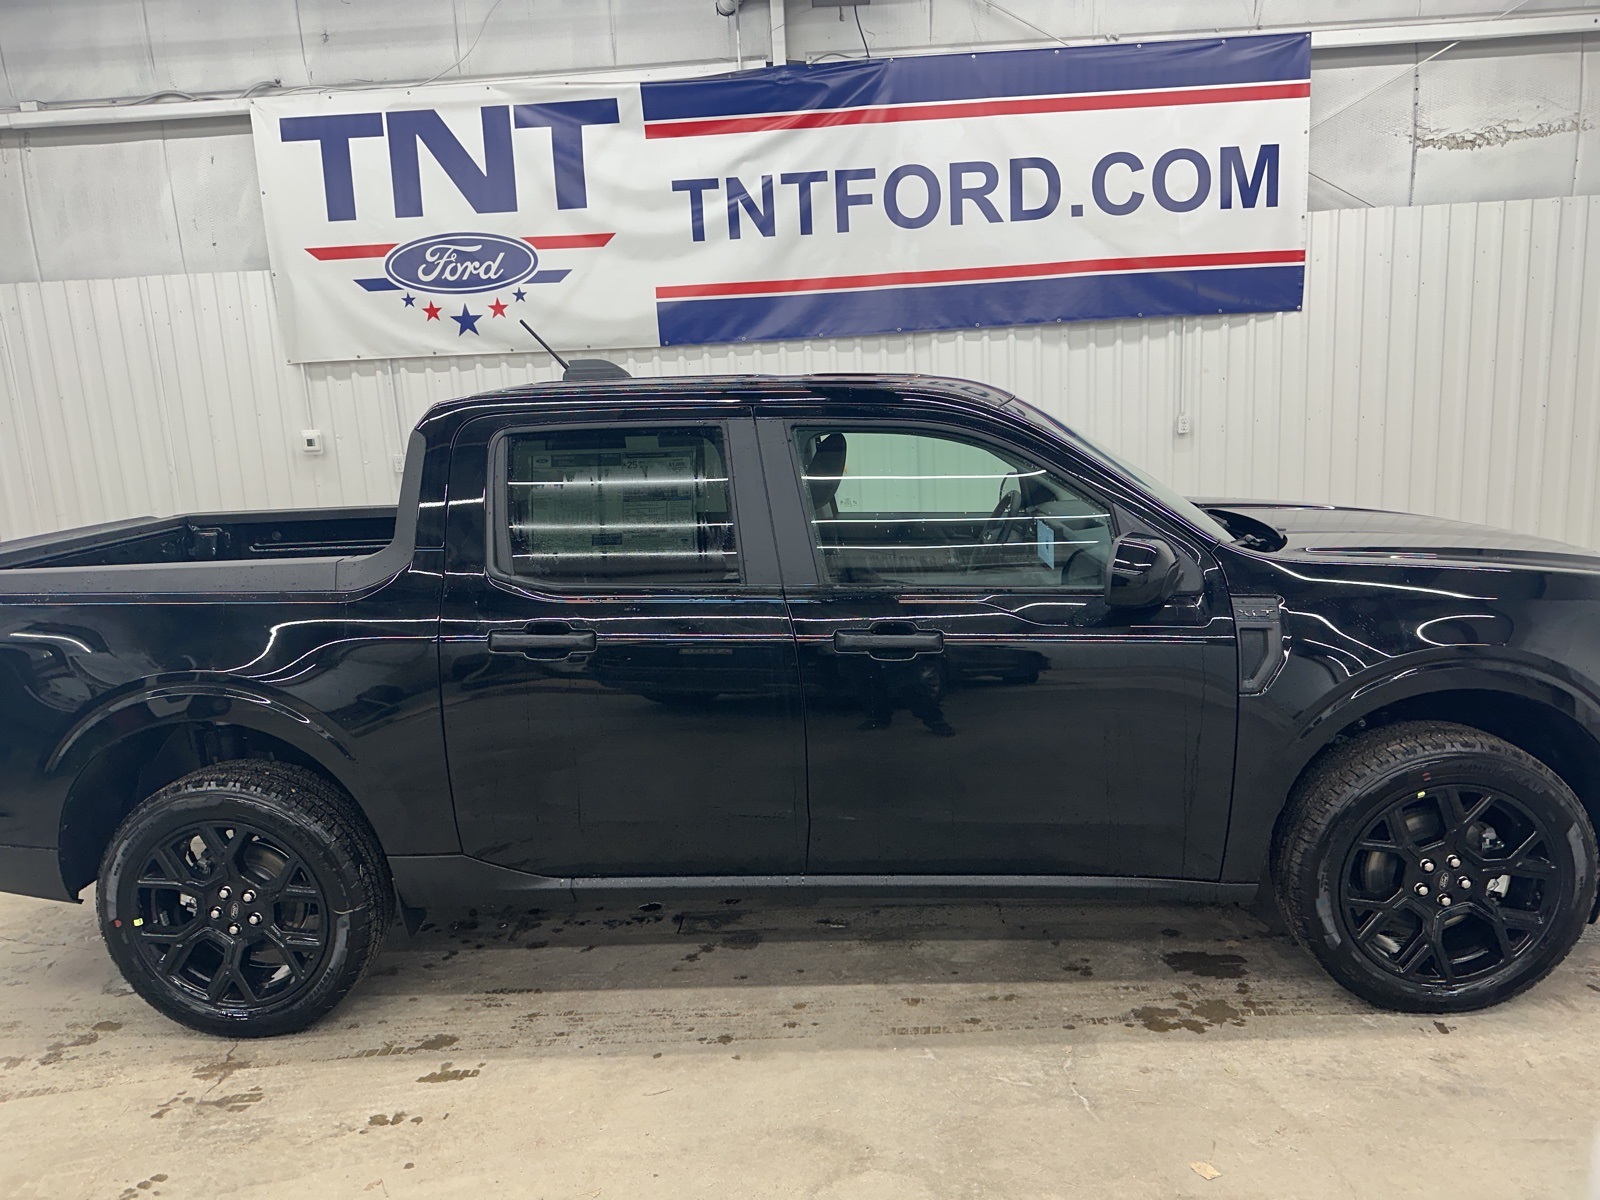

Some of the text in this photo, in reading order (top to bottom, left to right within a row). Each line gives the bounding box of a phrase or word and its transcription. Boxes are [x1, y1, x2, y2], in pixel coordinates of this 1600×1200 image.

[280, 98, 619, 221] TNT
[672, 144, 1279, 241] TNTFORD.COM
[418, 245, 504, 282] Ford
